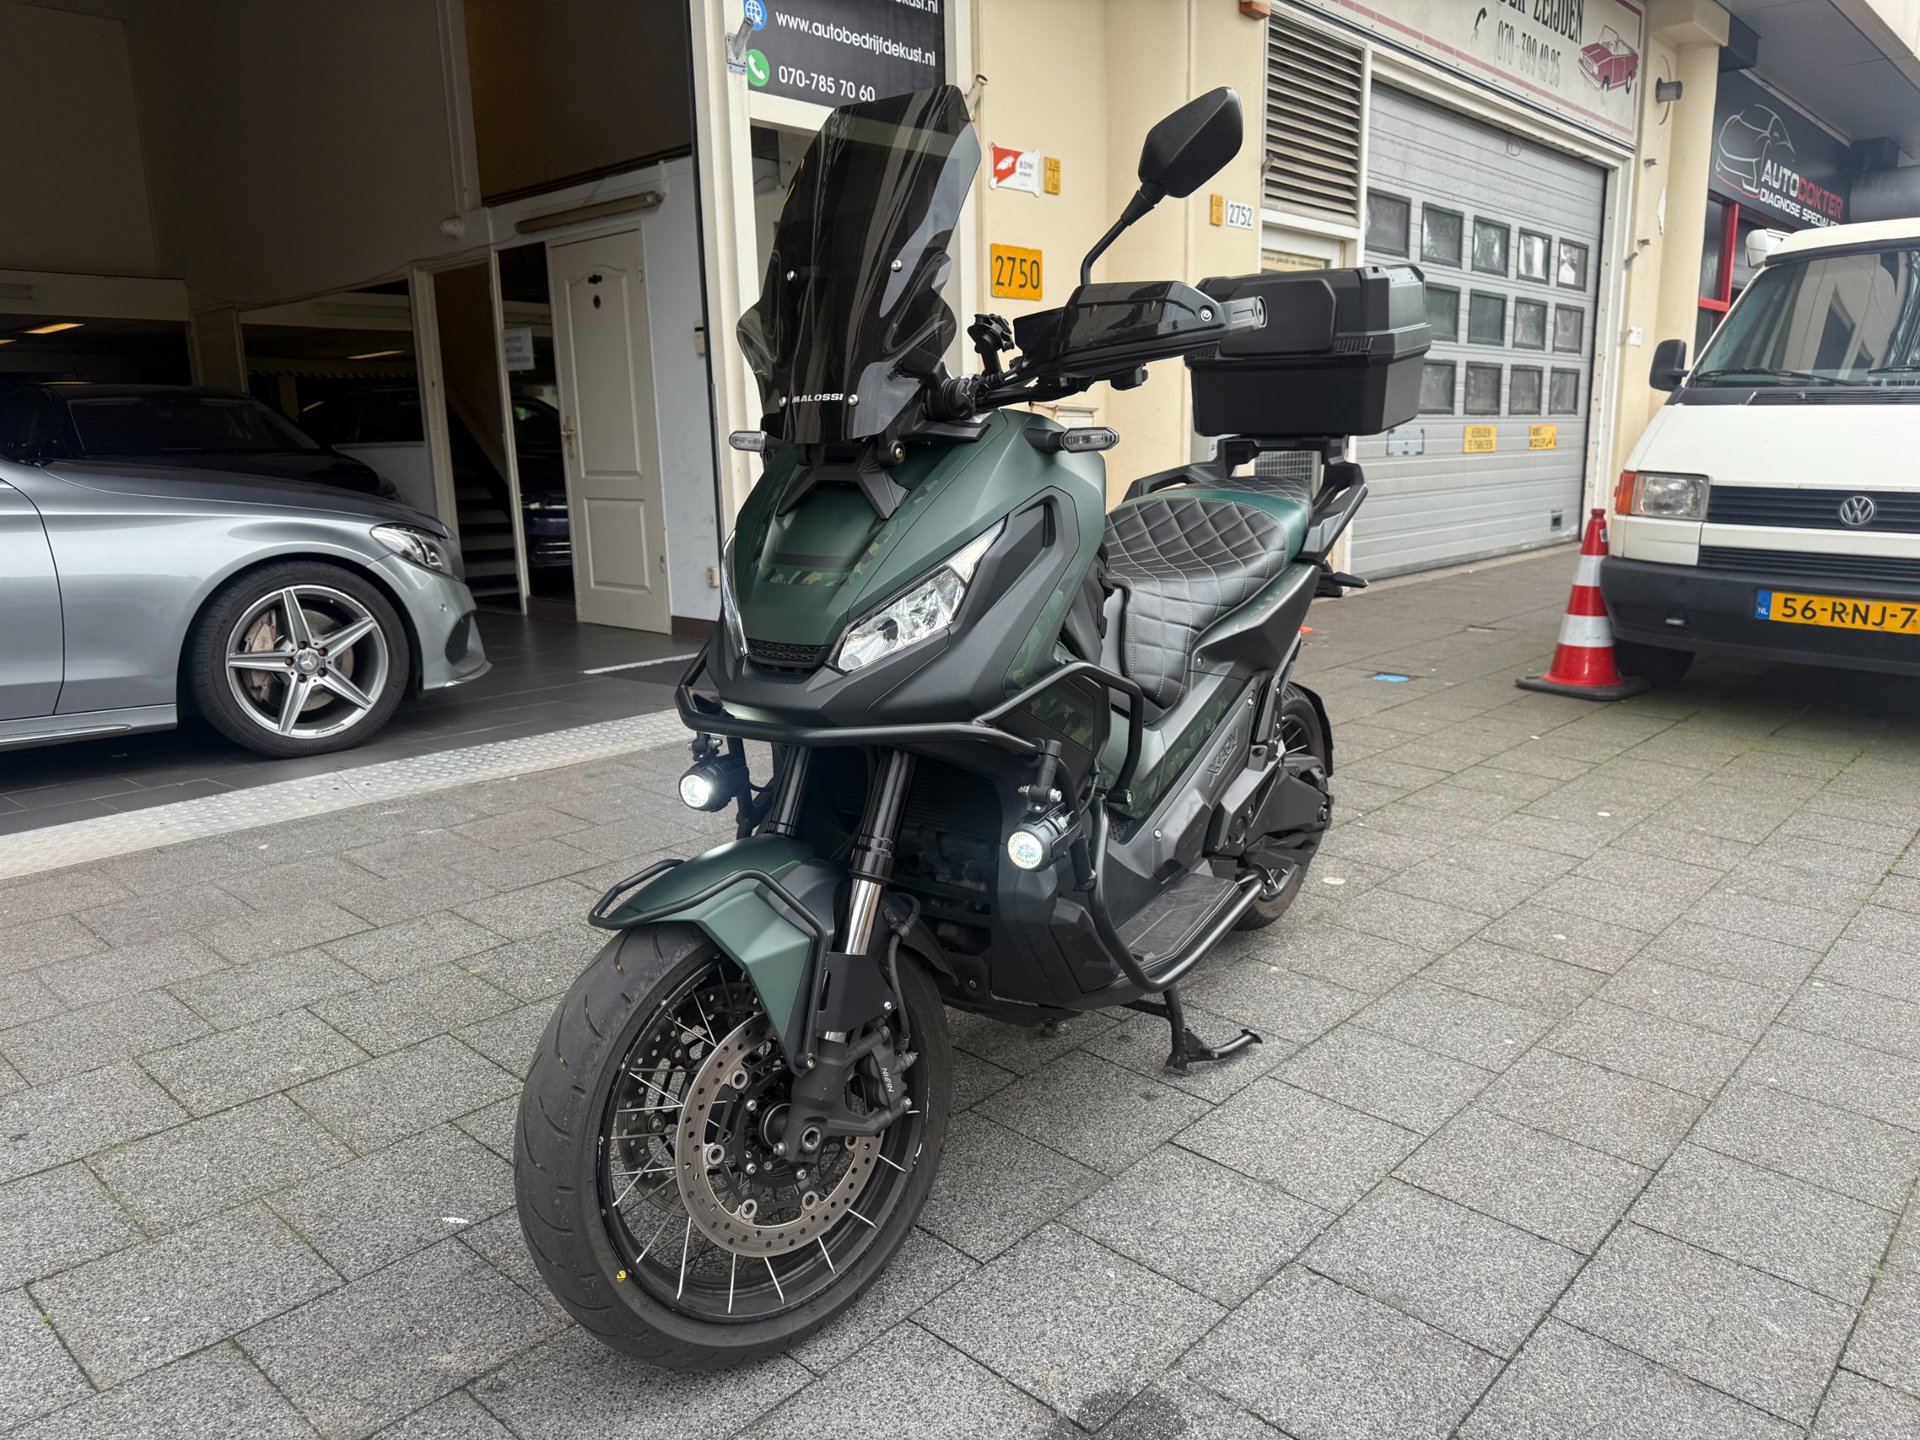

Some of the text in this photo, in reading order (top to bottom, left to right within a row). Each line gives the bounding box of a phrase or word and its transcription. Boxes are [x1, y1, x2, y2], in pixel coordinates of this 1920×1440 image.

[776, 12, 936, 66] www.autobedrijfdekust.nl
[778, 66, 876, 102] 070-785 70 60
[1761, 159, 1843, 219] AUTODOKTER
[1229, 203, 1253, 227] 2752
[1760, 187, 1841, 228] DIAGNOSE SPECIAL
[995, 255, 1040, 290] 2750
[792, 393, 844, 403] MALOSSI
[1757, 606, 1768, 615] NL
[1781, 597, 1918, 629] 56-RNJ-7
